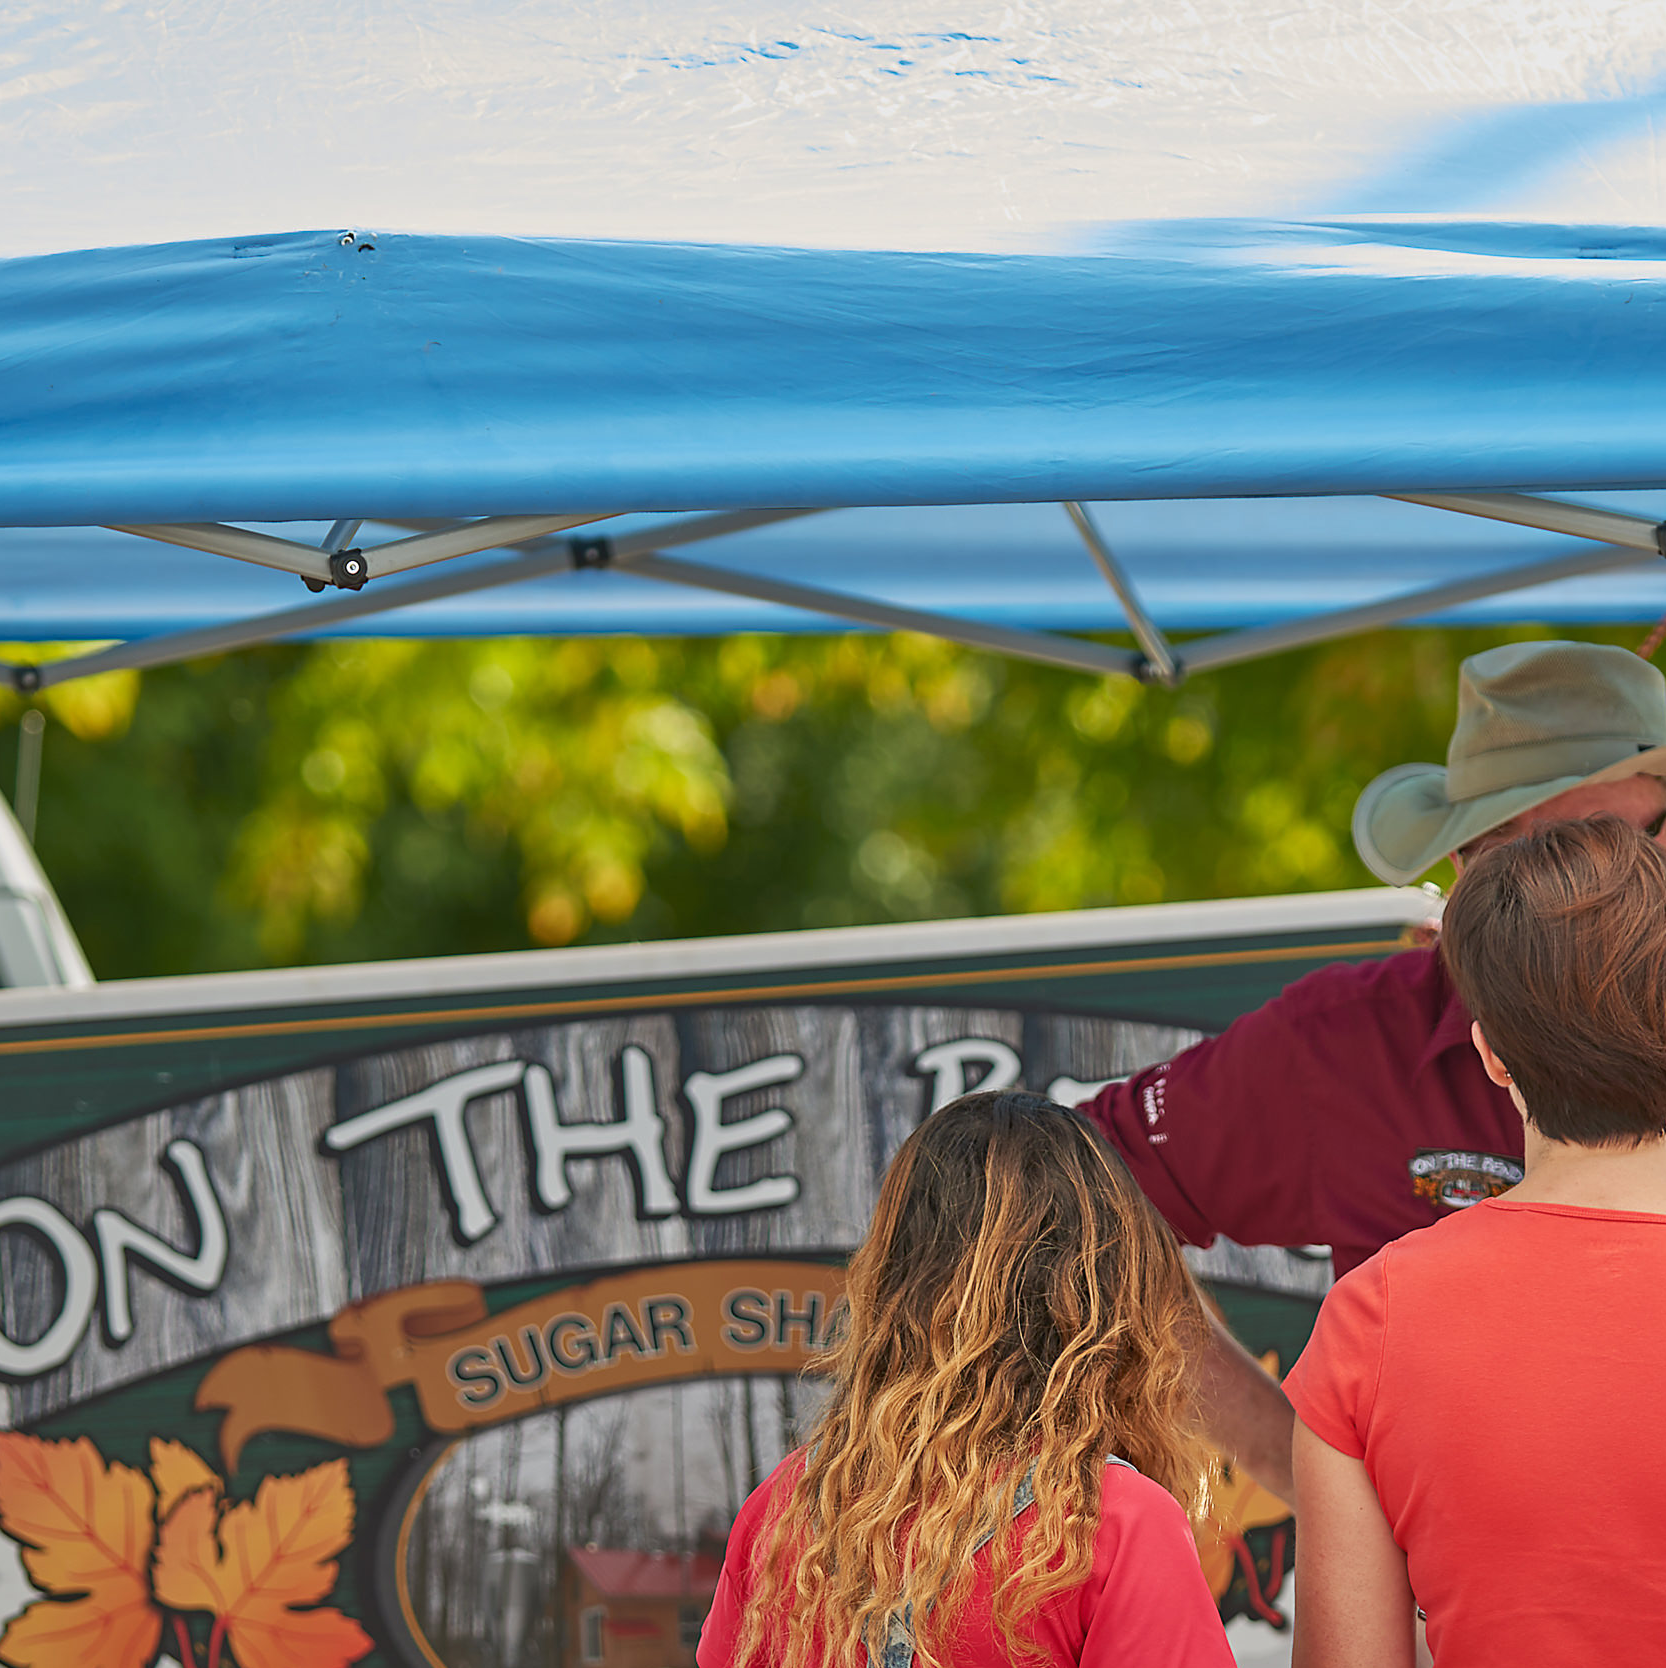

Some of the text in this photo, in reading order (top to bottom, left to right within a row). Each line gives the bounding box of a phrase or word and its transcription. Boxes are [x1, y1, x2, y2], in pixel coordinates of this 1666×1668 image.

[325, 1045, 806, 1242] THE
[1439, 1152, 1478, 1169] THE
[446, 1293, 696, 1408] SUGAR
